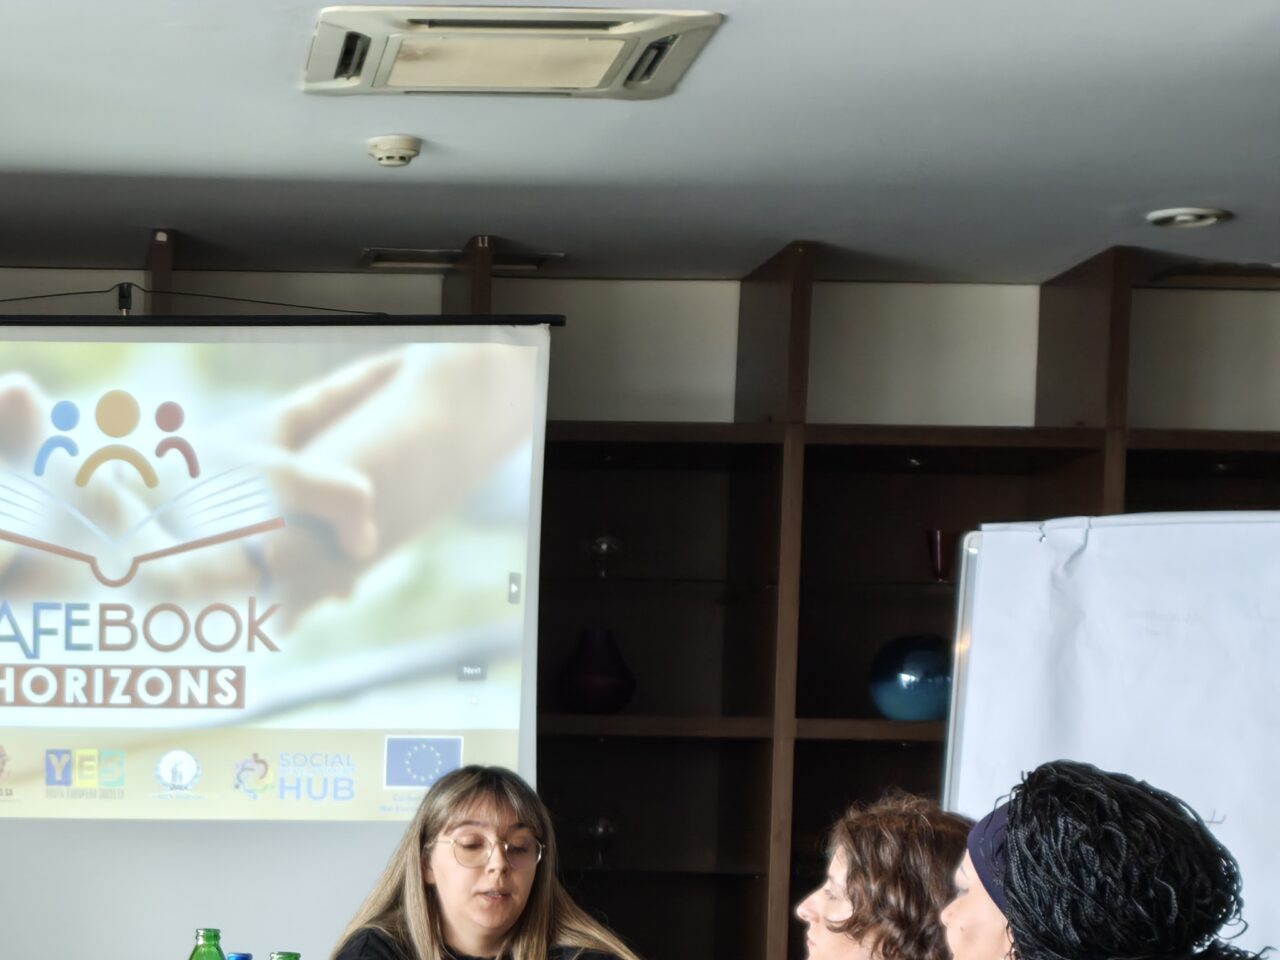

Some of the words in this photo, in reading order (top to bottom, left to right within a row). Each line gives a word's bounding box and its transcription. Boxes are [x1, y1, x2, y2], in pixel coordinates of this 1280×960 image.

[47, 752, 124, 784] YES
[279, 752, 354, 767] SOCIAL
[279, 776, 354, 800] HUB
